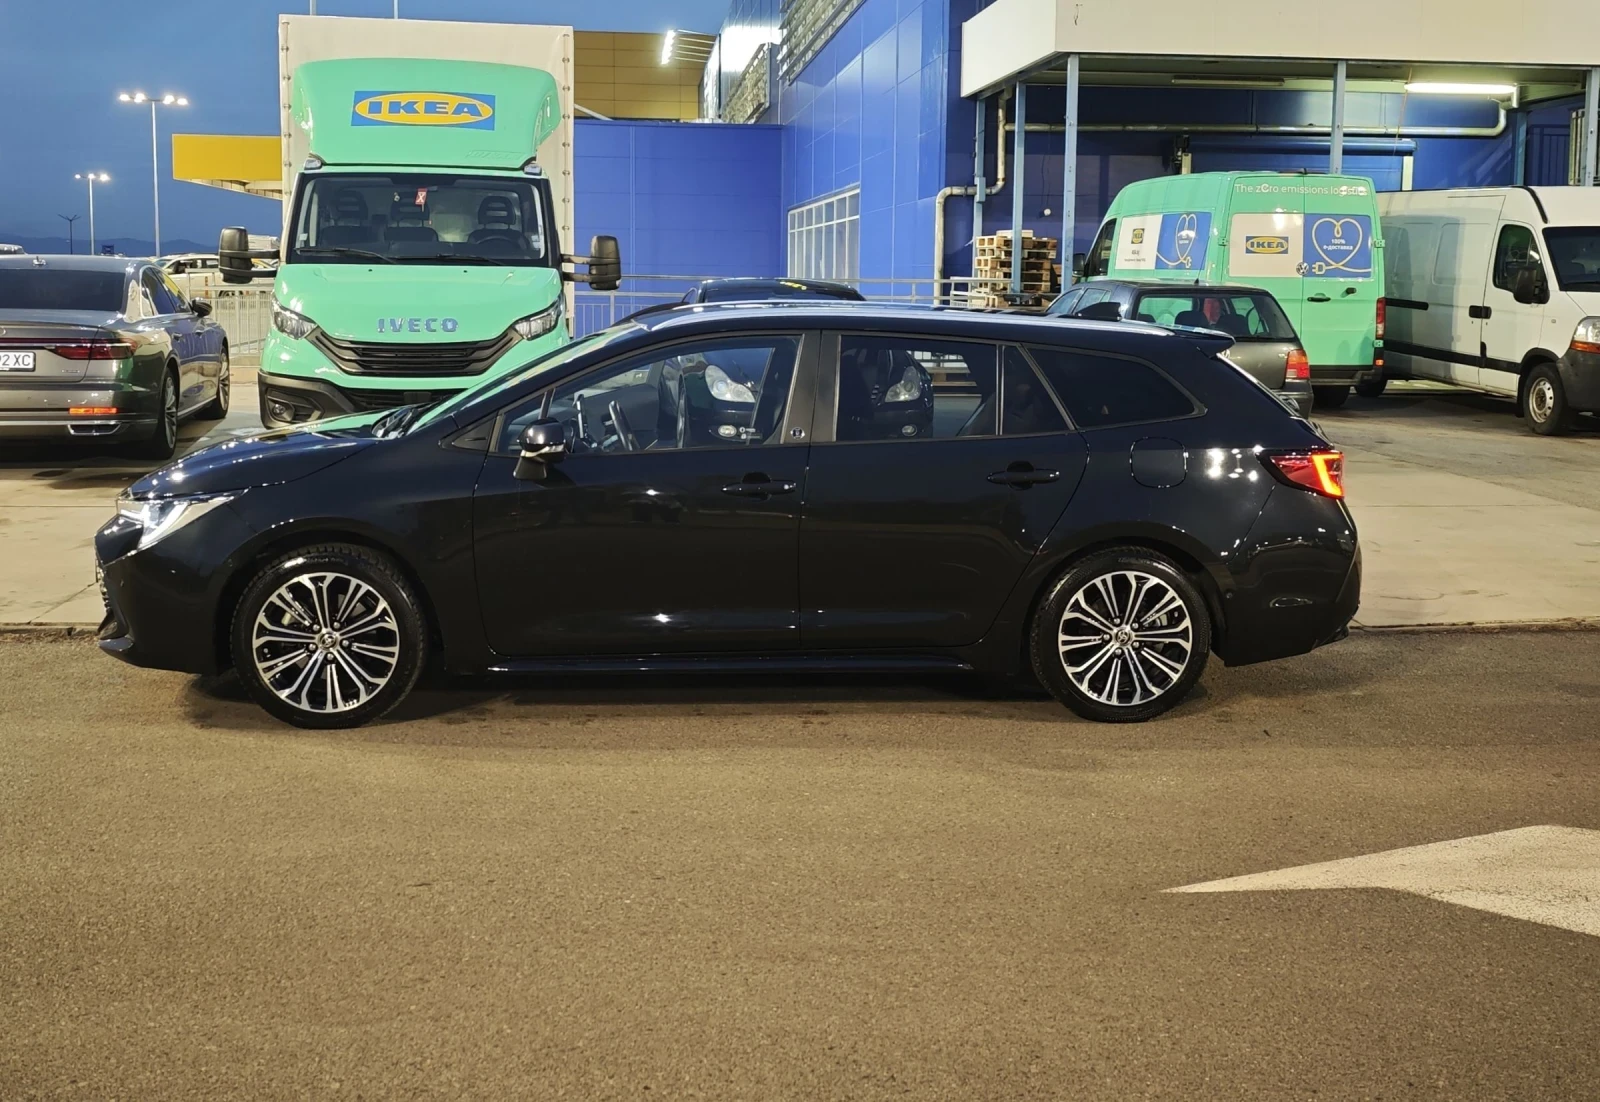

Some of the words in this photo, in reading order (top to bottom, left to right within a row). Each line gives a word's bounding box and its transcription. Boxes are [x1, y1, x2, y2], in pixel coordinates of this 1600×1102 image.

[367, 100, 484, 118] IKEA
[1234, 184, 1254, 193] The
[1281, 184, 1329, 195] emissions
[1249, 241, 1286, 249] IKEA
[377, 317, 459, 334] IVECO
[0, 353, 11, 367] 2
[13, 353, 32, 367] XC
